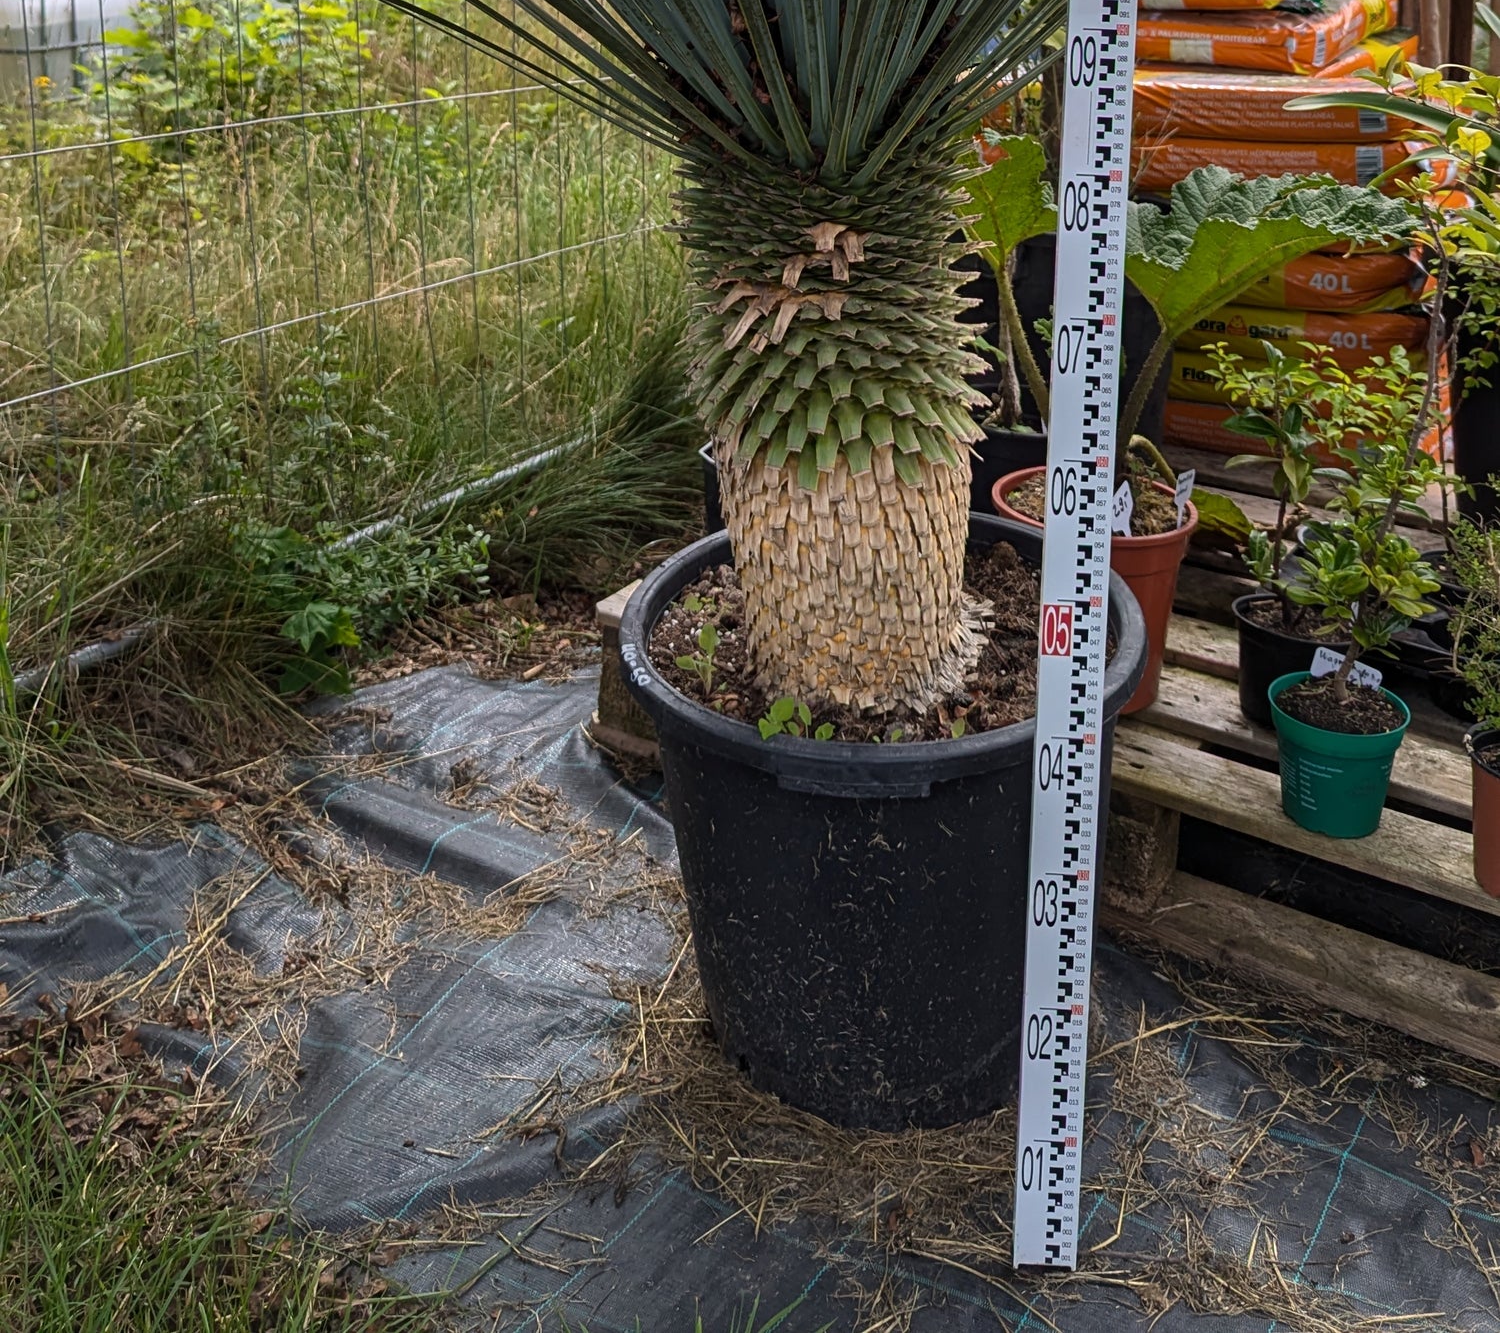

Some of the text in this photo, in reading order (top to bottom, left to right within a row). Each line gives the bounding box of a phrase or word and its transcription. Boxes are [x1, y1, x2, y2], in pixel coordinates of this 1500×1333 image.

[1118, 11, 1130, 19] 091
[1070, 36, 1096, 86] 09
[1110, 186, 1122, 194] 079
[1064, 180, 1089, 232] 08
[1109, 200, 1121, 208] 078
[1108, 229, 1120, 237] 076
[1106, 258, 1118, 266] 074
[1106, 272, 1118, 280] 073
[1309, 272, 1352, 293] 40 L
[1328, 332, 1372, 350] 40 L
[1058, 324, 1084, 374] 07
[1096, 471, 1108, 479] 059
[1050, 466, 1076, 516] 06
[1096, 485, 1108, 493] 058
[1095, 499, 1107, 507] 057
[1095, 513, 1106, 521] 056
[1094, 527, 1106, 535] 055
[1093, 541, 1105, 549] 054
[1093, 555, 1105, 563] 053
[1044, 606, 1070, 655] 05
[1089, 638, 1101, 646] 047
[1088, 652, 1100, 660] 046
[1086, 707, 1098, 715] 042
[1039, 744, 1064, 791] 04
[1083, 762, 1095, 770] 038
[1080, 830, 1092, 838] 033
[1079, 857, 1091, 865] 031
[1078, 884, 1089, 892] 029
[1032, 878, 1058, 927] 03
[1076, 911, 1088, 919] 027
[1075, 938, 1087, 946] 025
[1073, 978, 1085, 986] 022
[1071, 1018, 1083, 1026] 019
[1027, 1014, 1051, 1060] 02
[1069, 1071, 1081, 1079] 015
[1065, 1150, 1077, 1158] 009
[1022, 1146, 1043, 1191] 01
